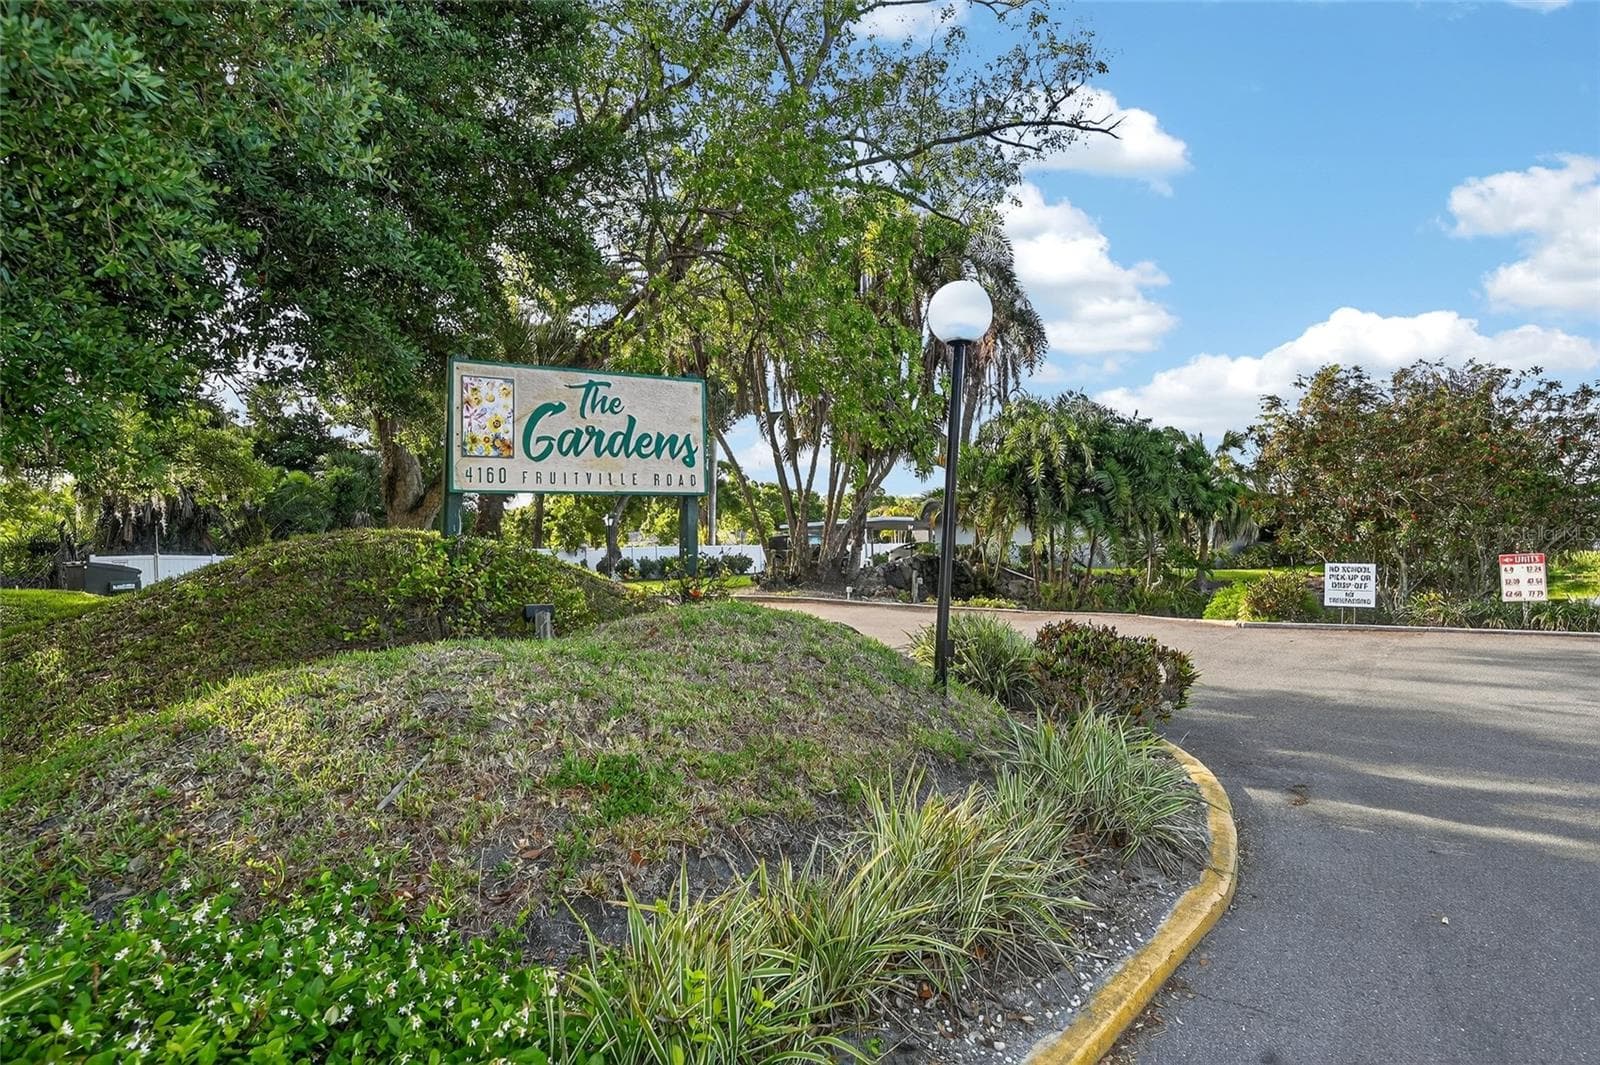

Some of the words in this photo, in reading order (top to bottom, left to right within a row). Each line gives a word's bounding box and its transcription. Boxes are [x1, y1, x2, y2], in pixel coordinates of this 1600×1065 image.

[564, 379, 625, 419] The
[522, 401, 700, 468] Gardens
[465, 466, 507, 484] 4160
[522, 471, 639, 486] FRUITVILLE
[653, 473, 697, 487] ROAD
[1514, 554, 1539, 564] UNITS
[1341, 566, 1371, 574] SCHOOL
